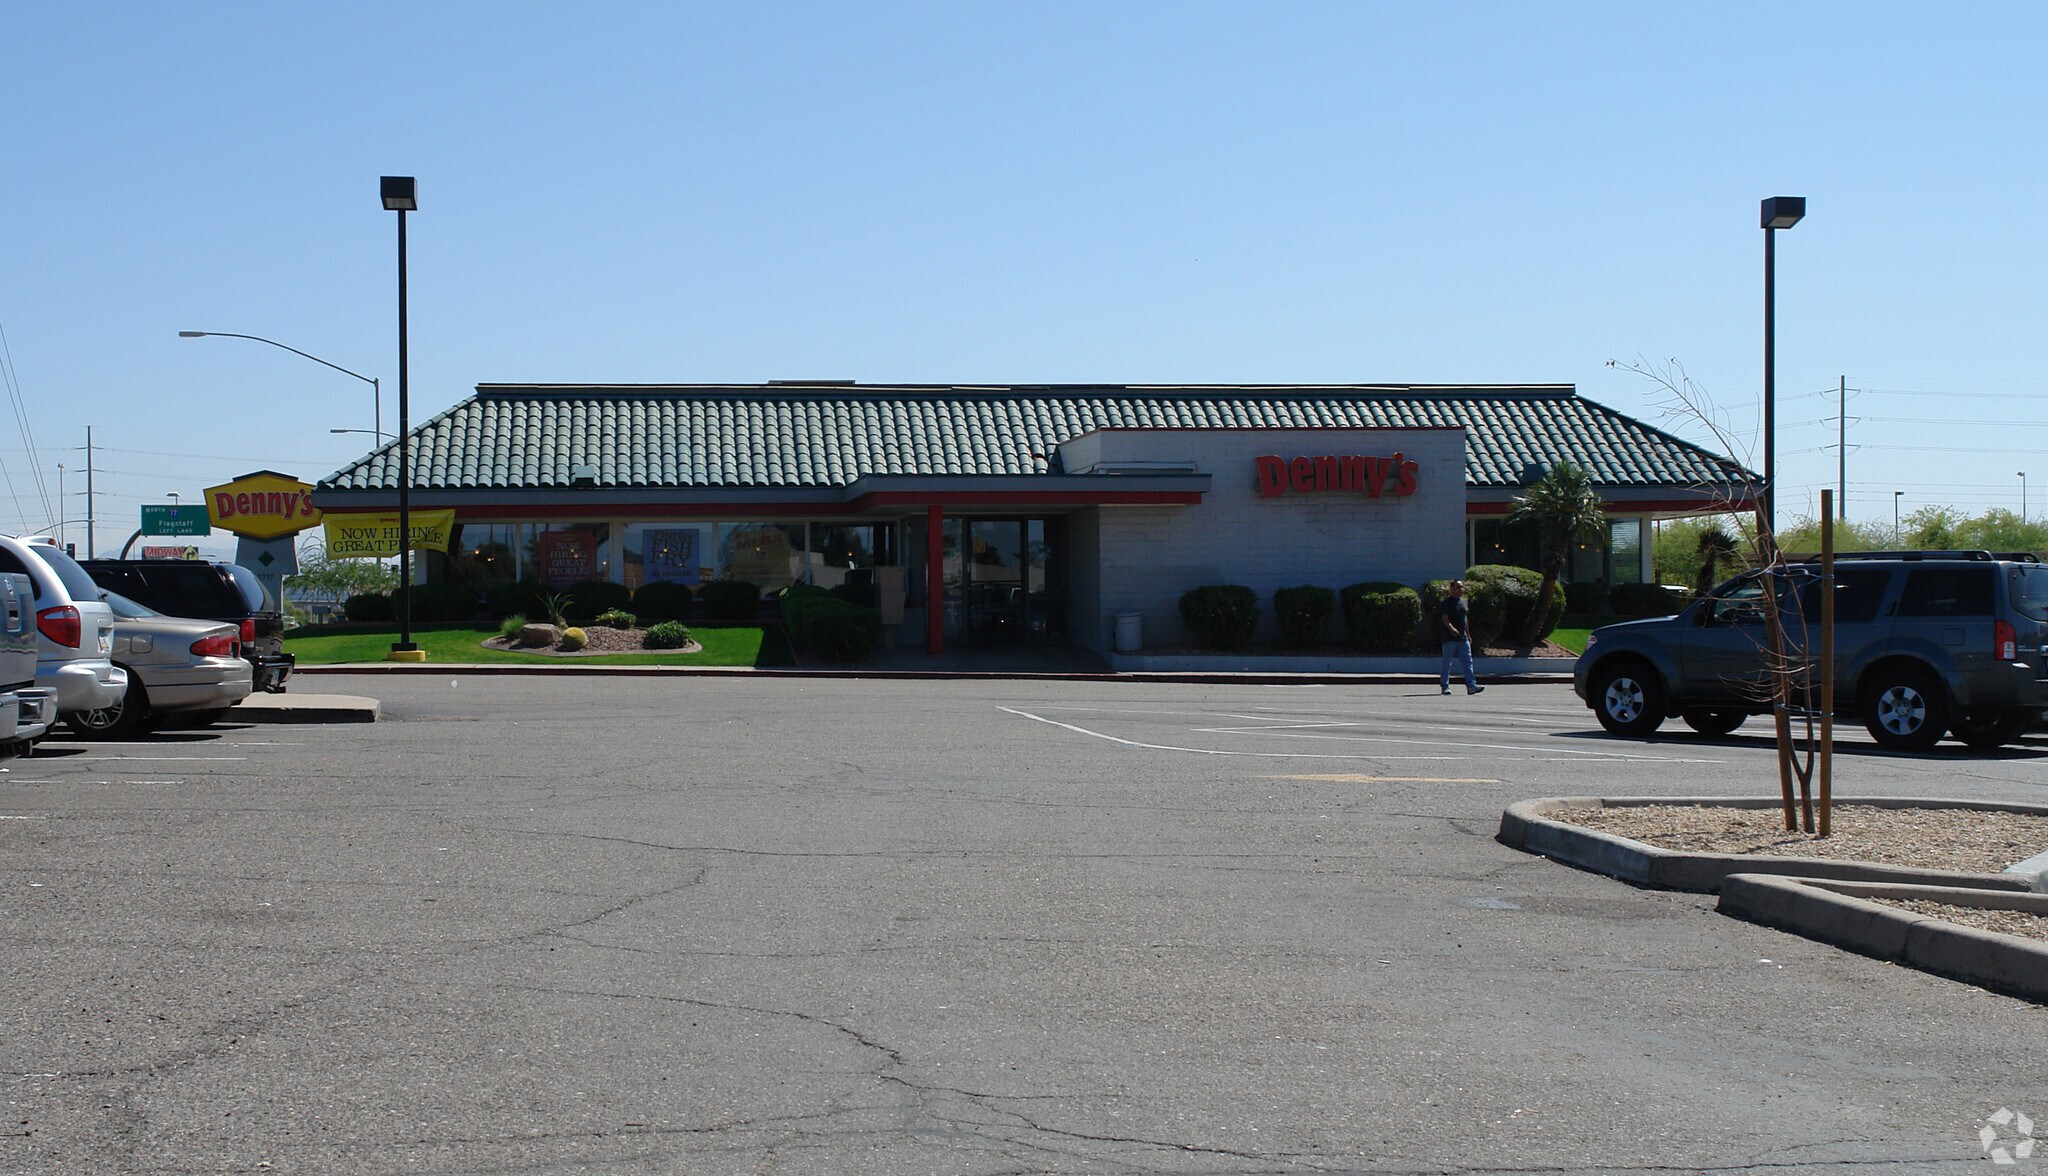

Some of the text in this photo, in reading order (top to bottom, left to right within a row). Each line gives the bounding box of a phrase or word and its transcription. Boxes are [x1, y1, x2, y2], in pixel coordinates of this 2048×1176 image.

[1255, 451, 1419, 499] Denny's
[214, 488, 314, 520] Denny's
[158, 520, 194, 528] Flagstaff
[341, 525, 438, 540] NOW HIIN
[144, 546, 184, 557] MIDWAY
[333, 540, 385, 553] GREAT
[556, 542, 581, 550] NOW
[652, 538, 692, 554] FISH
[551, 559, 586, 567] GREAT
[649, 550, 691, 568] FRY
